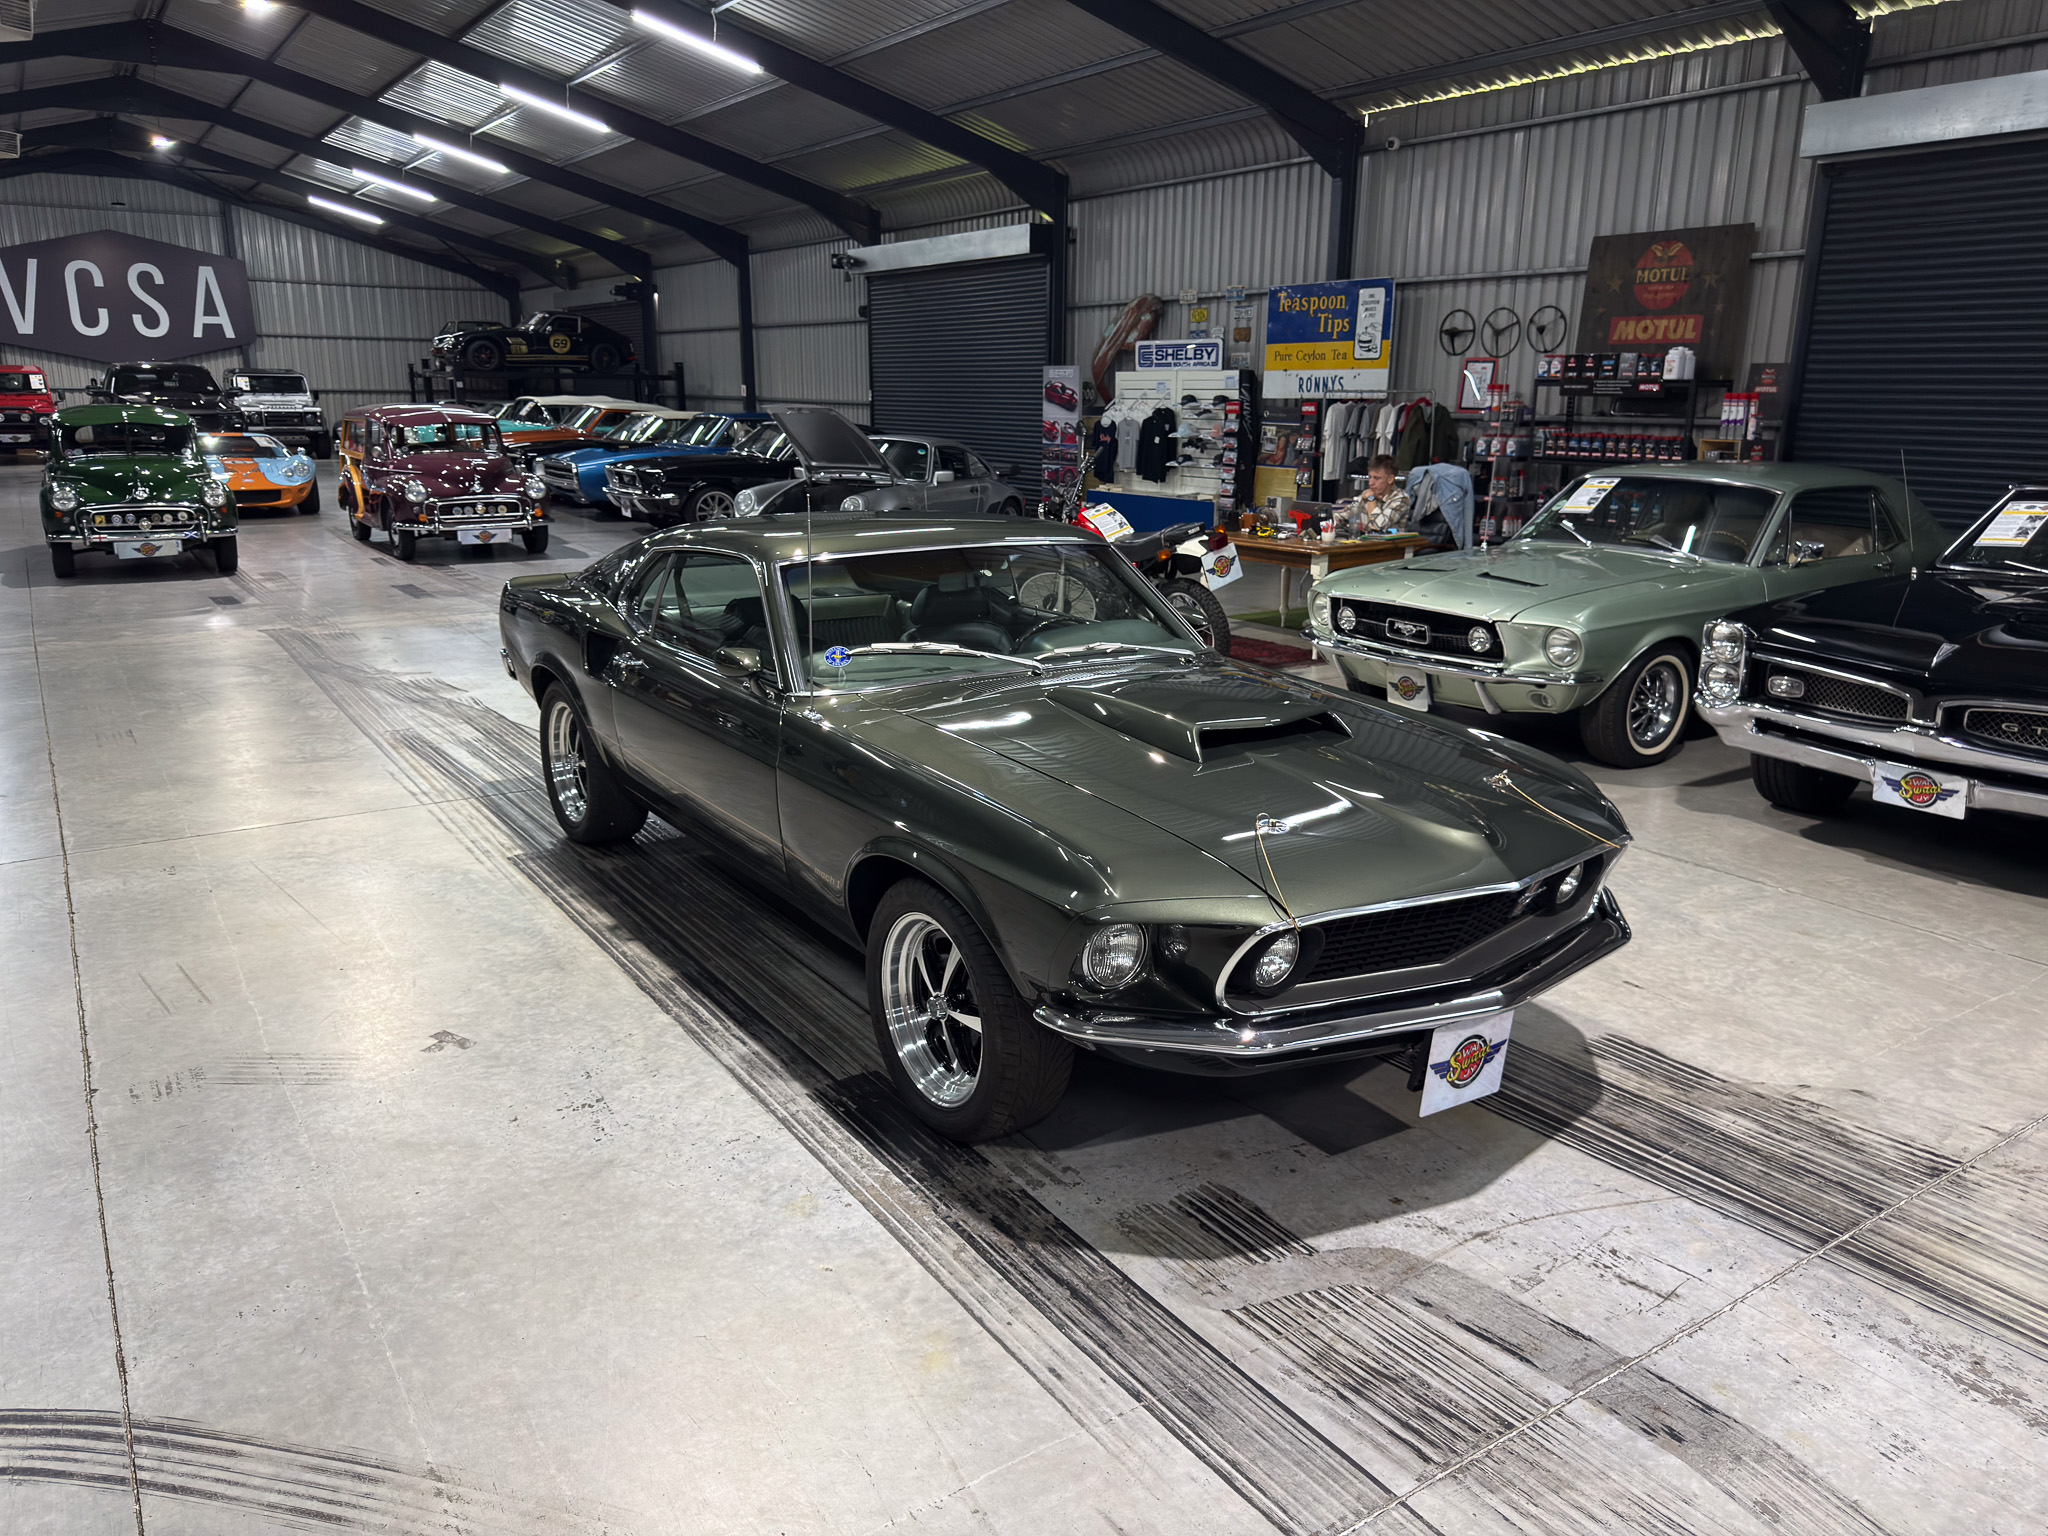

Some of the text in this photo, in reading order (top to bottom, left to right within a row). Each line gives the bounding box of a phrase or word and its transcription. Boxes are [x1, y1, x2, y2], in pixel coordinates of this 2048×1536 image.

[1636, 267, 1689, 284] MOTUL
[1278, 292, 1346, 317] Teaspoon
[1318, 313, 1350, 339] Tips
[1612, 318, 1697, 340] MOTUL
[552, 339, 568, 348] 69
[1155, 348, 1216, 361] SHELBY
[1274, 348, 1347, 363] Pure Ceylon Tea
[1298, 376, 1344, 393] RONNYS
[1899, 779, 1943, 799] Swaai
[1447, 1038, 1492, 1082] Swaai
